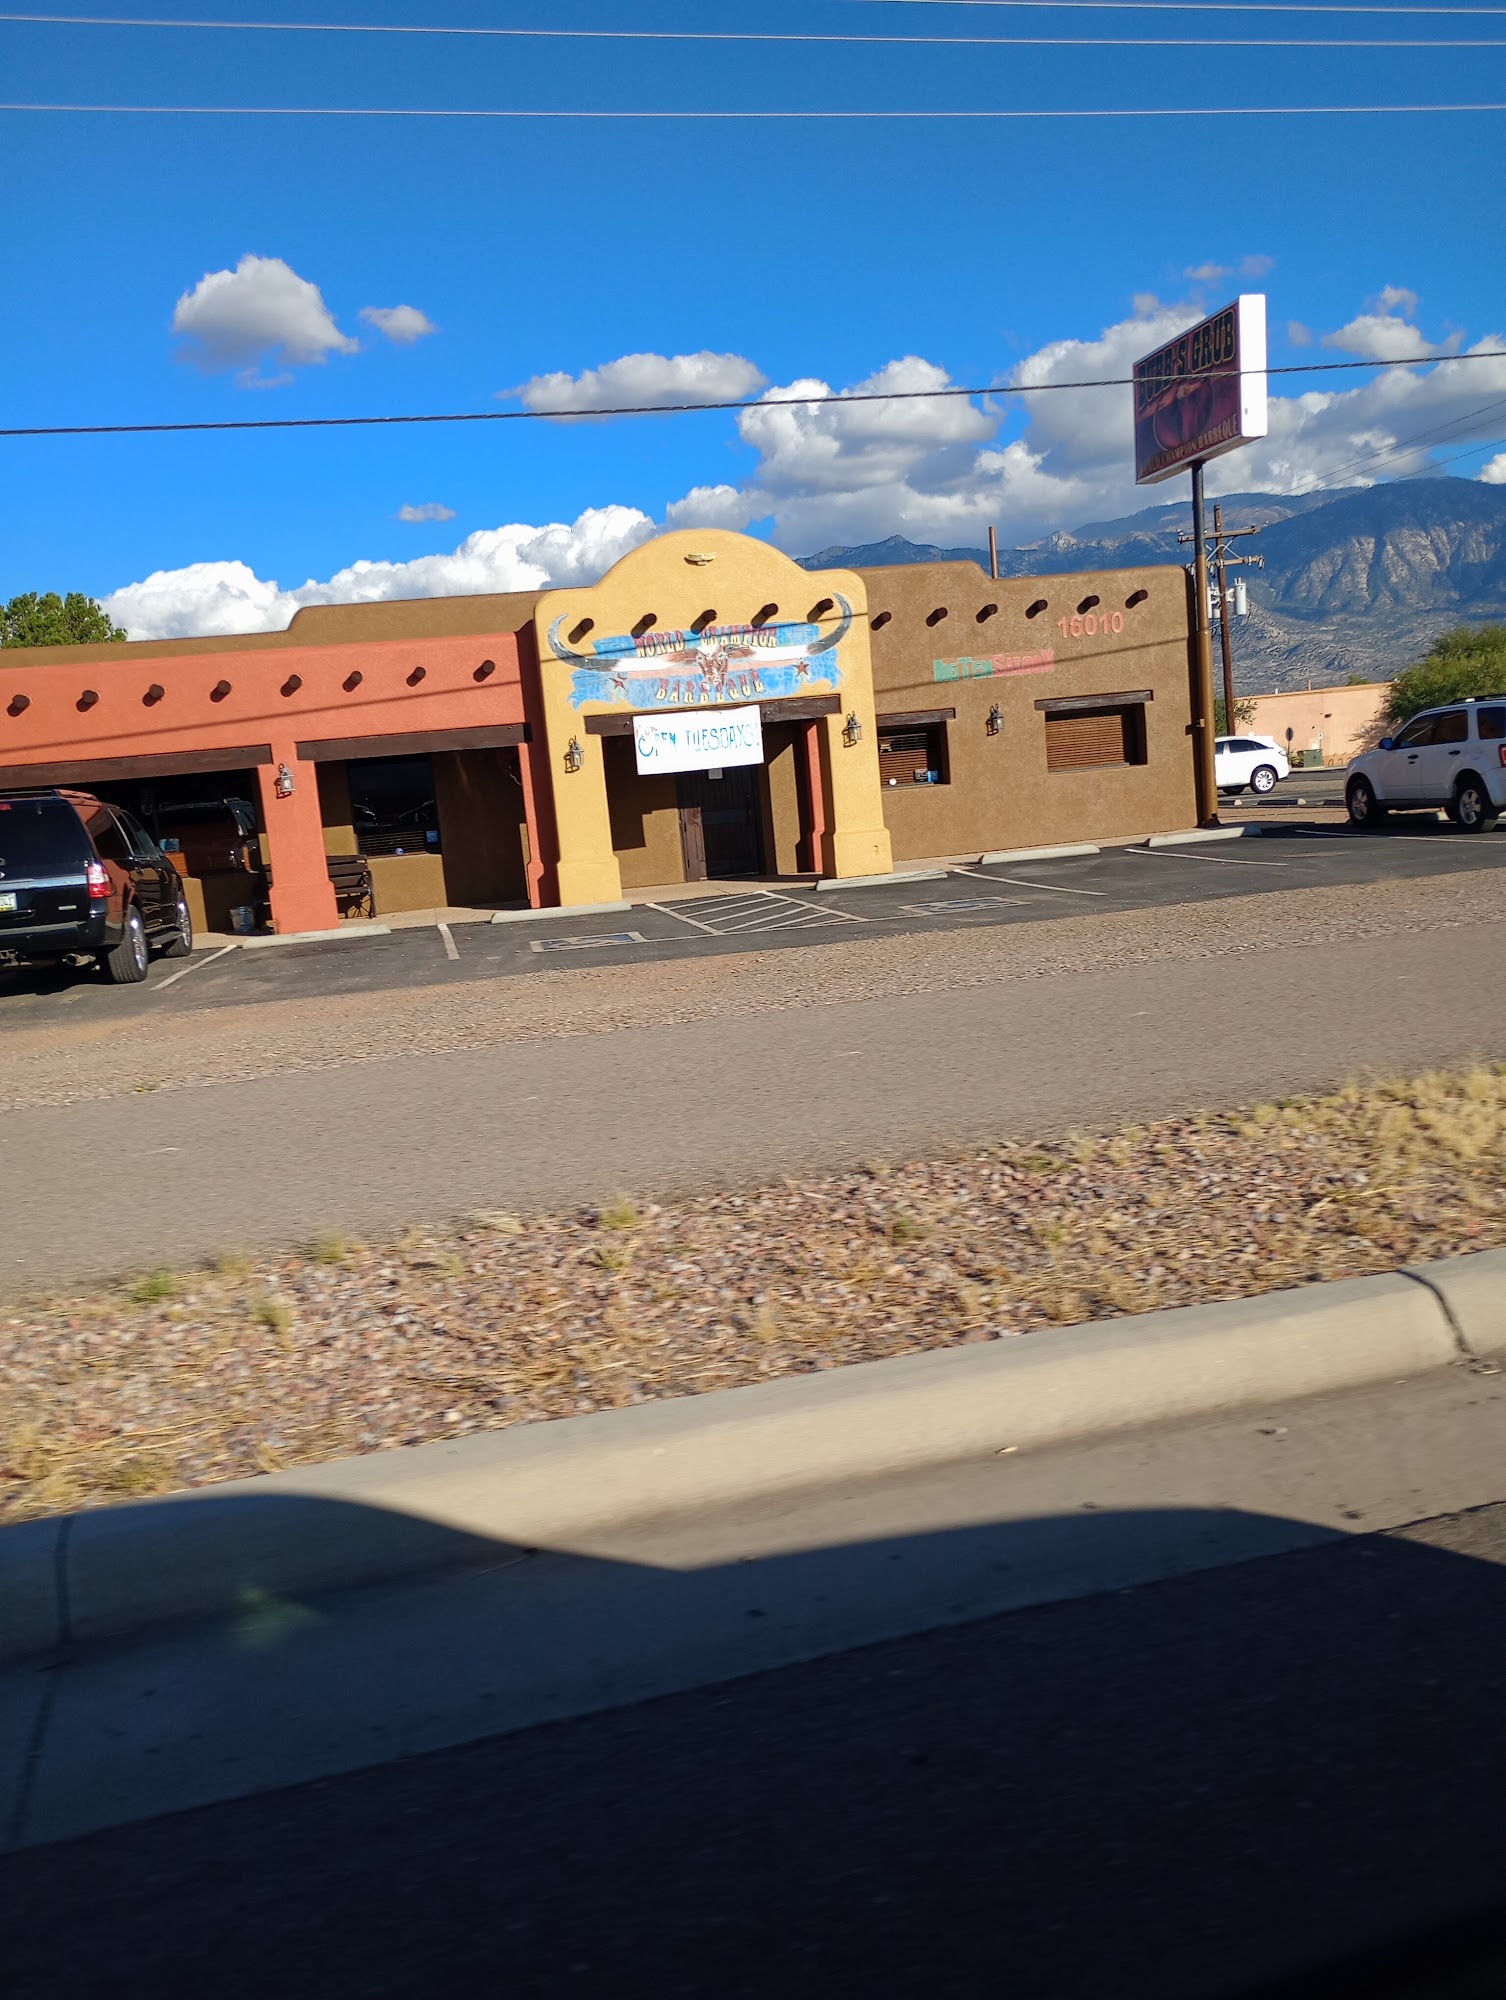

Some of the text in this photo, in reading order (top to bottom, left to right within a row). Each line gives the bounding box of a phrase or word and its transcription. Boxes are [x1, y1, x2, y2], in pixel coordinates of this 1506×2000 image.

[1191, 311, 1235, 373] GRUB
[1162, 441, 1198, 463] CHAMPION
[1057, 611, 1125, 638] 16010
[633, 625, 777, 658] WORLD CHAMPION
[656, 670, 765, 704] BARBEQUE
